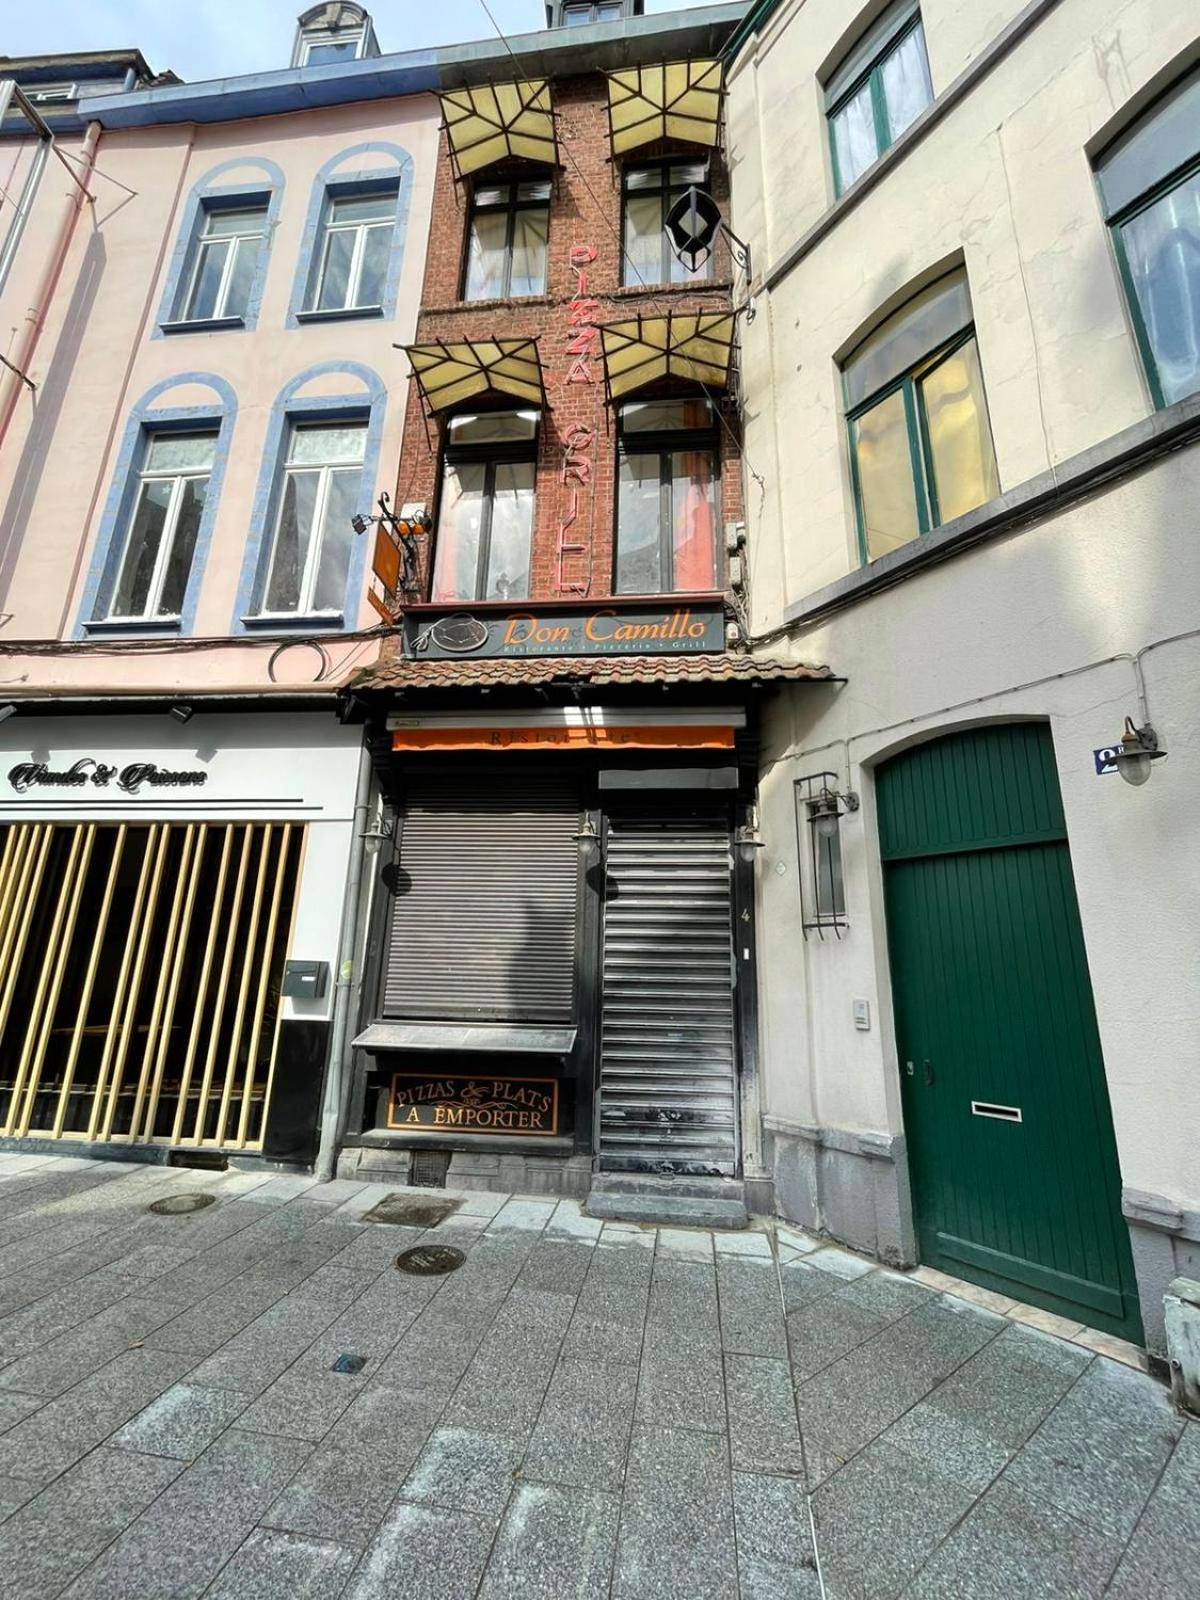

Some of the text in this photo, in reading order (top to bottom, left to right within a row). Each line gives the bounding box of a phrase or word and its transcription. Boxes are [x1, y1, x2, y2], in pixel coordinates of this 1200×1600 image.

[563, 244, 599, 385] PIZZA
[503, 608, 705, 644] Don Camillo
[672, 640, 706, 648] Grill
[741, 908, 751, 921] 4
[397, 1080, 552, 1113] PIZZAS & PLATS
[405, 1106, 420, 1122] A
